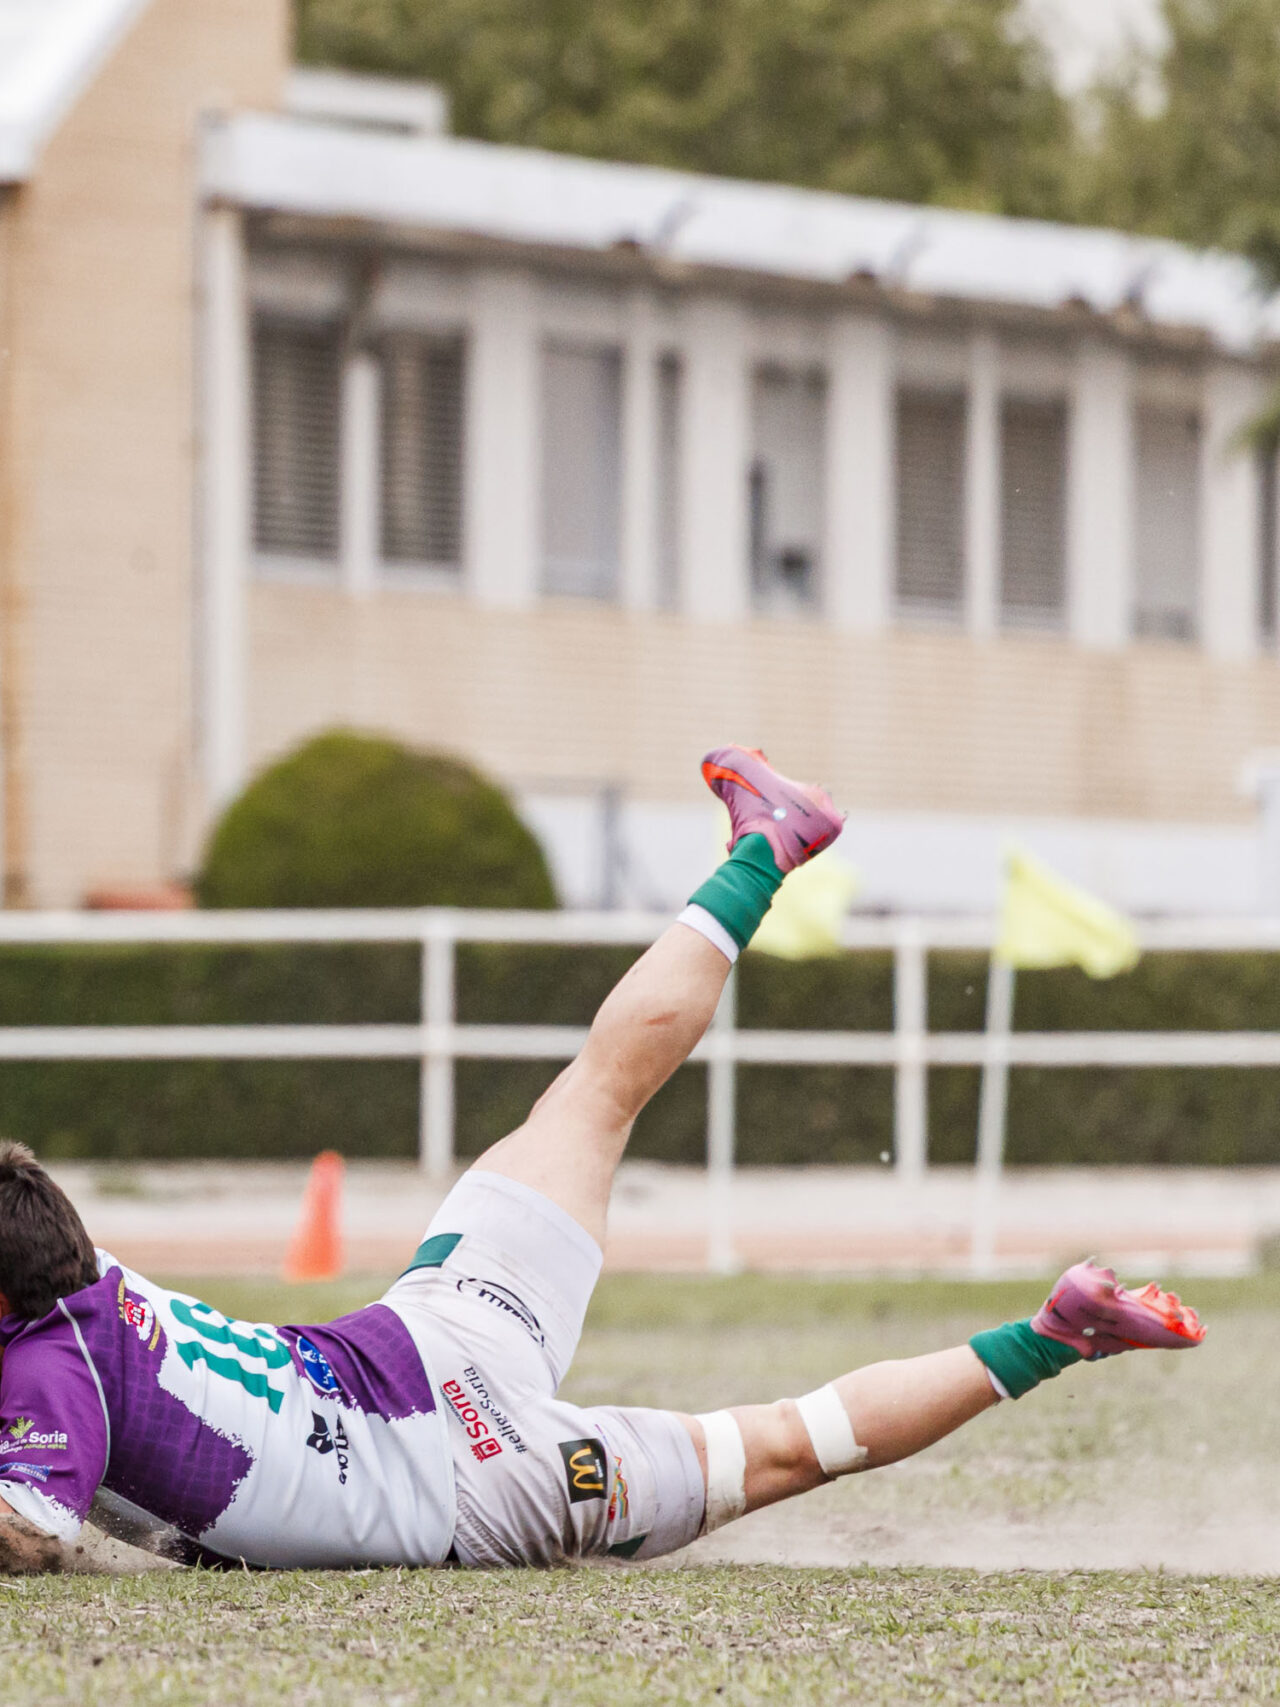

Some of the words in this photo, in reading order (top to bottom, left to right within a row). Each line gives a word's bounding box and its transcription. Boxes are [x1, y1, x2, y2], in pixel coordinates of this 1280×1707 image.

[29, 1430, 68, 1444] Soria
[442, 1379, 489, 1439] Soria
[463, 1366, 527, 1453] #eligeSoria
